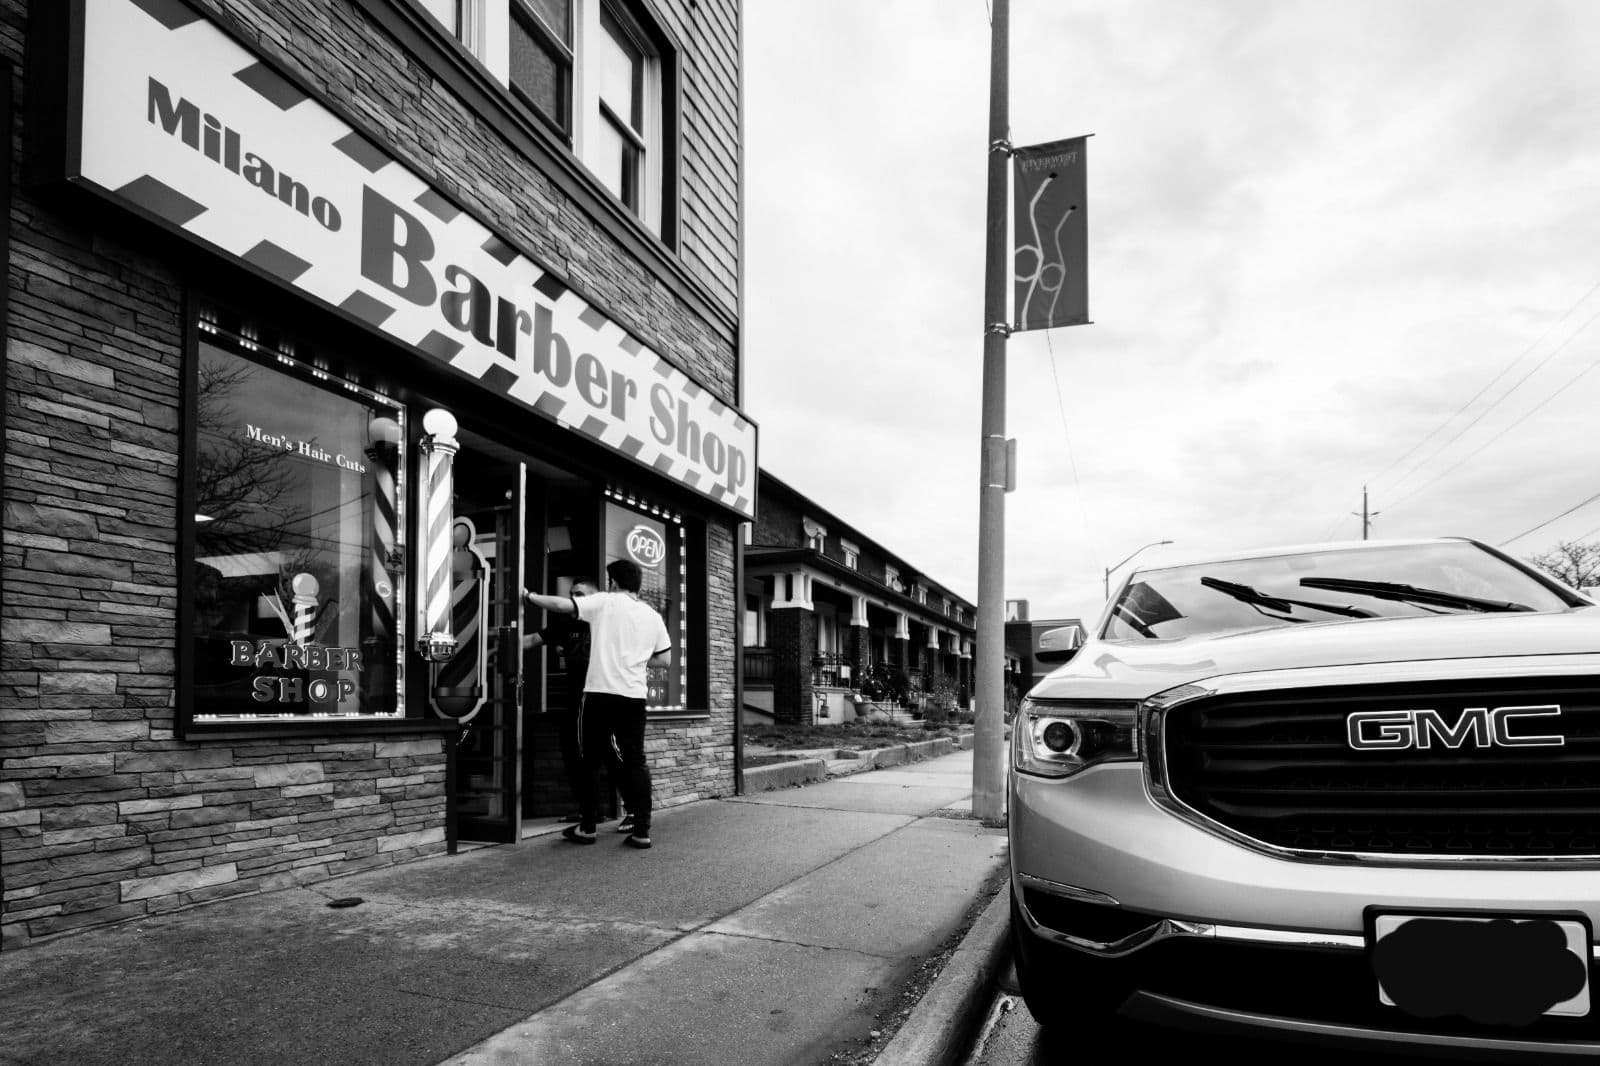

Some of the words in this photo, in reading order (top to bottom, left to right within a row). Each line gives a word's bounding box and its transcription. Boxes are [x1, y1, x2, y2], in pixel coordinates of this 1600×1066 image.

[147, 75, 342, 232] Milano
[360, 183, 638, 422] Barber
[649, 382, 747, 495] Shop
[246, 423, 293, 451] Men's
[298, 440, 331, 463] Hair
[335, 454, 366, 474] Cuts
[630, 533, 663, 559] OPEN
[230, 640, 364, 672] BARBER
[251, 676, 355, 703] SHOP
[1346, 704, 1565, 750] GMC
